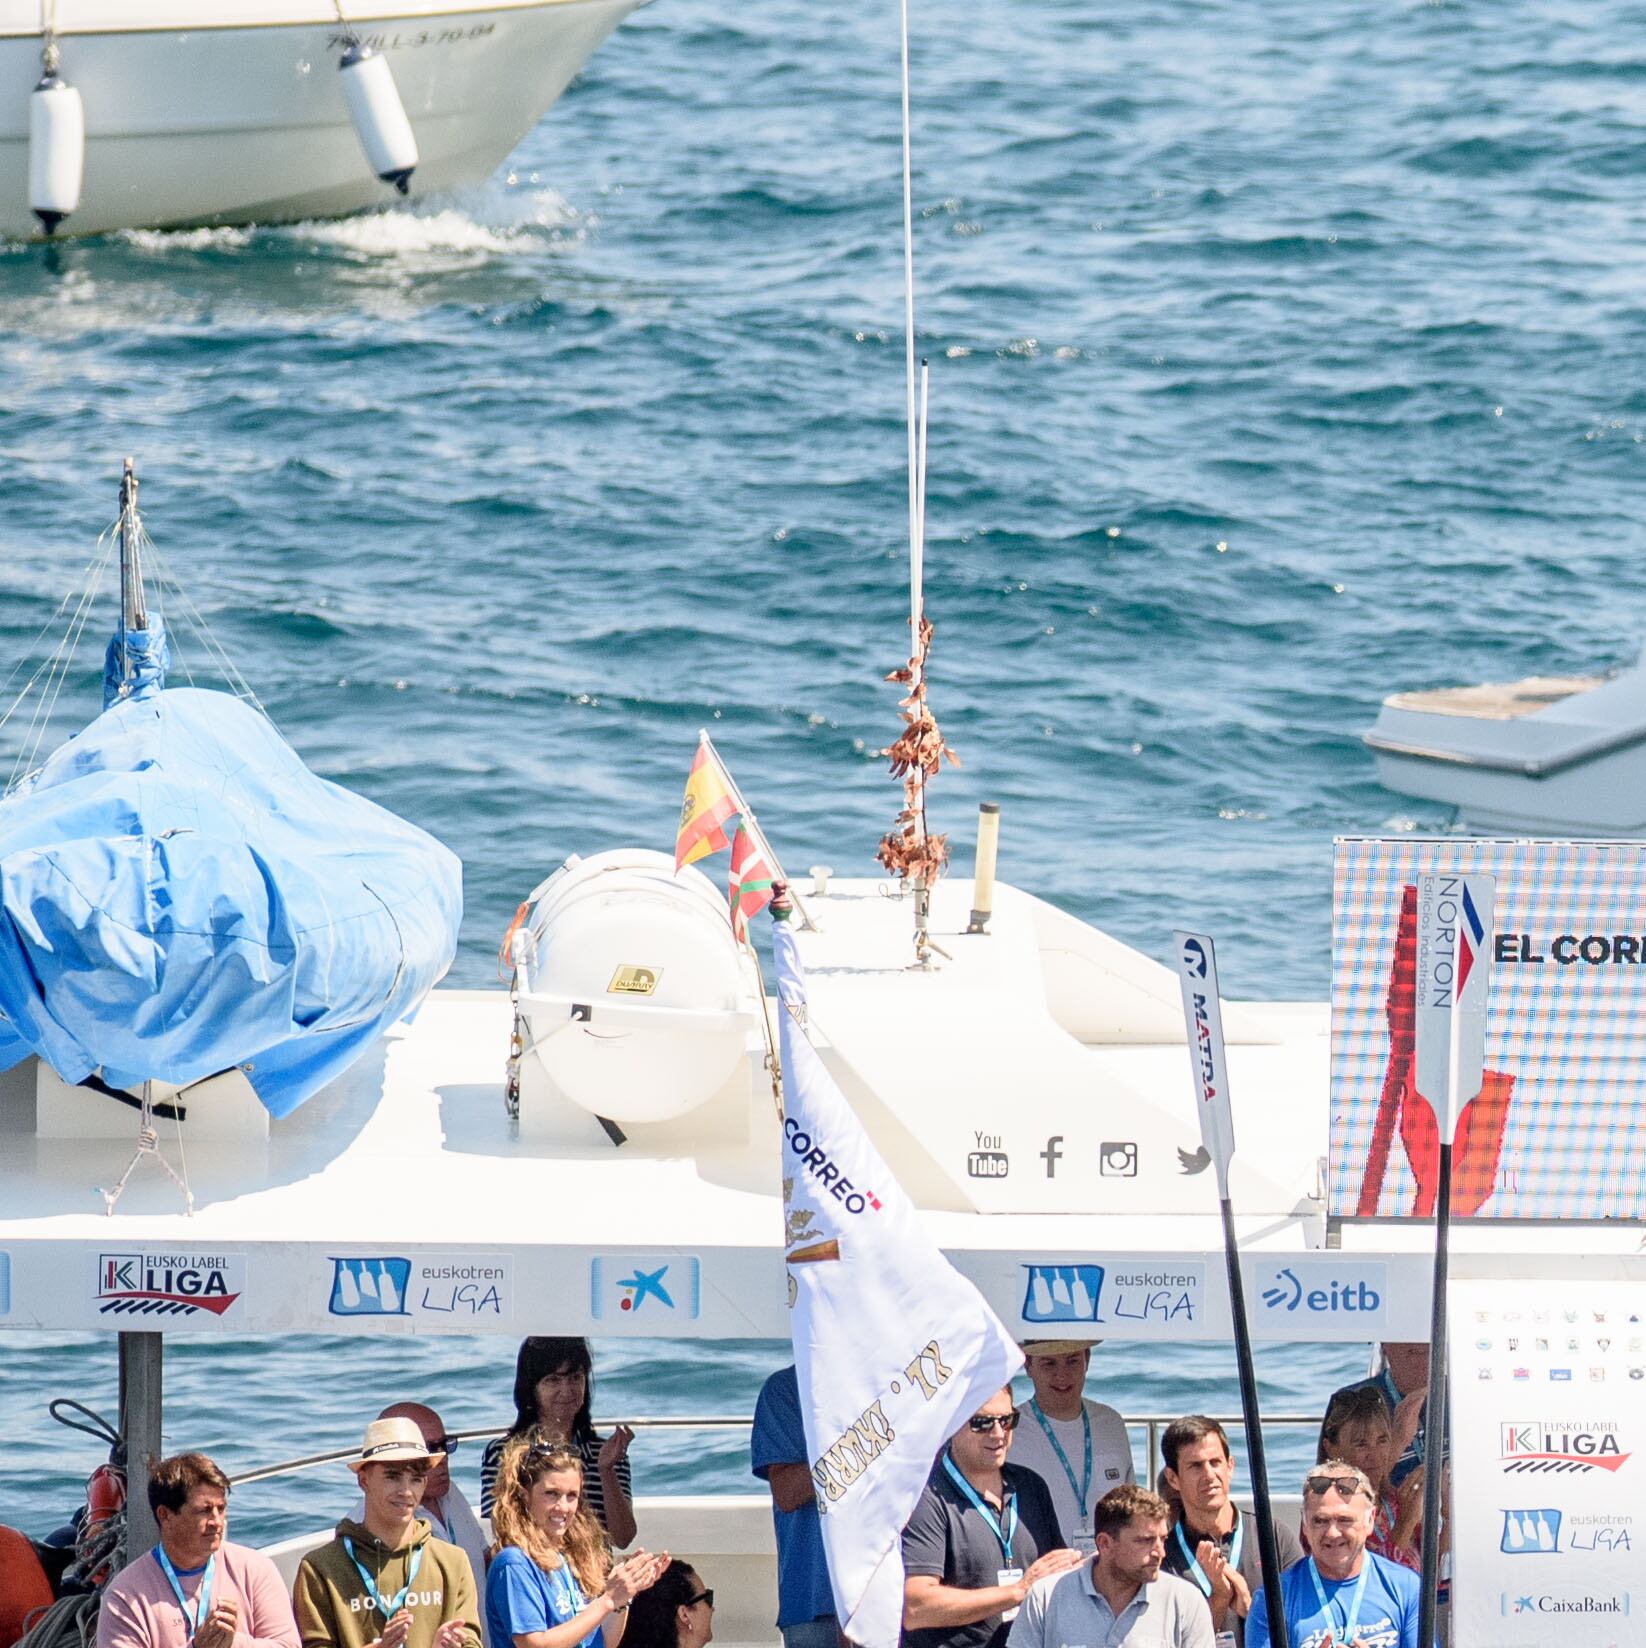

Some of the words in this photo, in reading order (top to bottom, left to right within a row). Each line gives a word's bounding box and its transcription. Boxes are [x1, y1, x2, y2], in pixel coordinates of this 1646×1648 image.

[1422, 876, 1435, 927] Edificios
[1432, 877, 1459, 1009] NORTON
[1495, 934, 1544, 965] EL
[1193, 993, 1216, 1102] MATRA
[975, 1131, 1002, 1149] You
[970, 1155, 1008, 1176] Tube
[146, 1255, 187, 1269] EUSKO
[191, 1255, 229, 1269] LABEL
[421, 1264, 504, 1281] euskotren
[147, 1270, 228, 1294] LIGA
[1115, 1271, 1196, 1287] euskotren
[421, 1284, 503, 1315] LIGA
[1115, 1290, 1195, 1322] LIGA
[1308, 1281, 1380, 1313] eitb
[1544, 1422, 1583, 1433] EUSKO
[1585, 1422, 1621, 1433] LABEL
[1545, 1434, 1621, 1455] LIGA
[1570, 1514, 1633, 1526] euskotren
[1570, 1528, 1632, 1551] LIGA
[350, 1590, 442, 1612] BONOUR
[1538, 1595, 1621, 1614] CaixaBank
